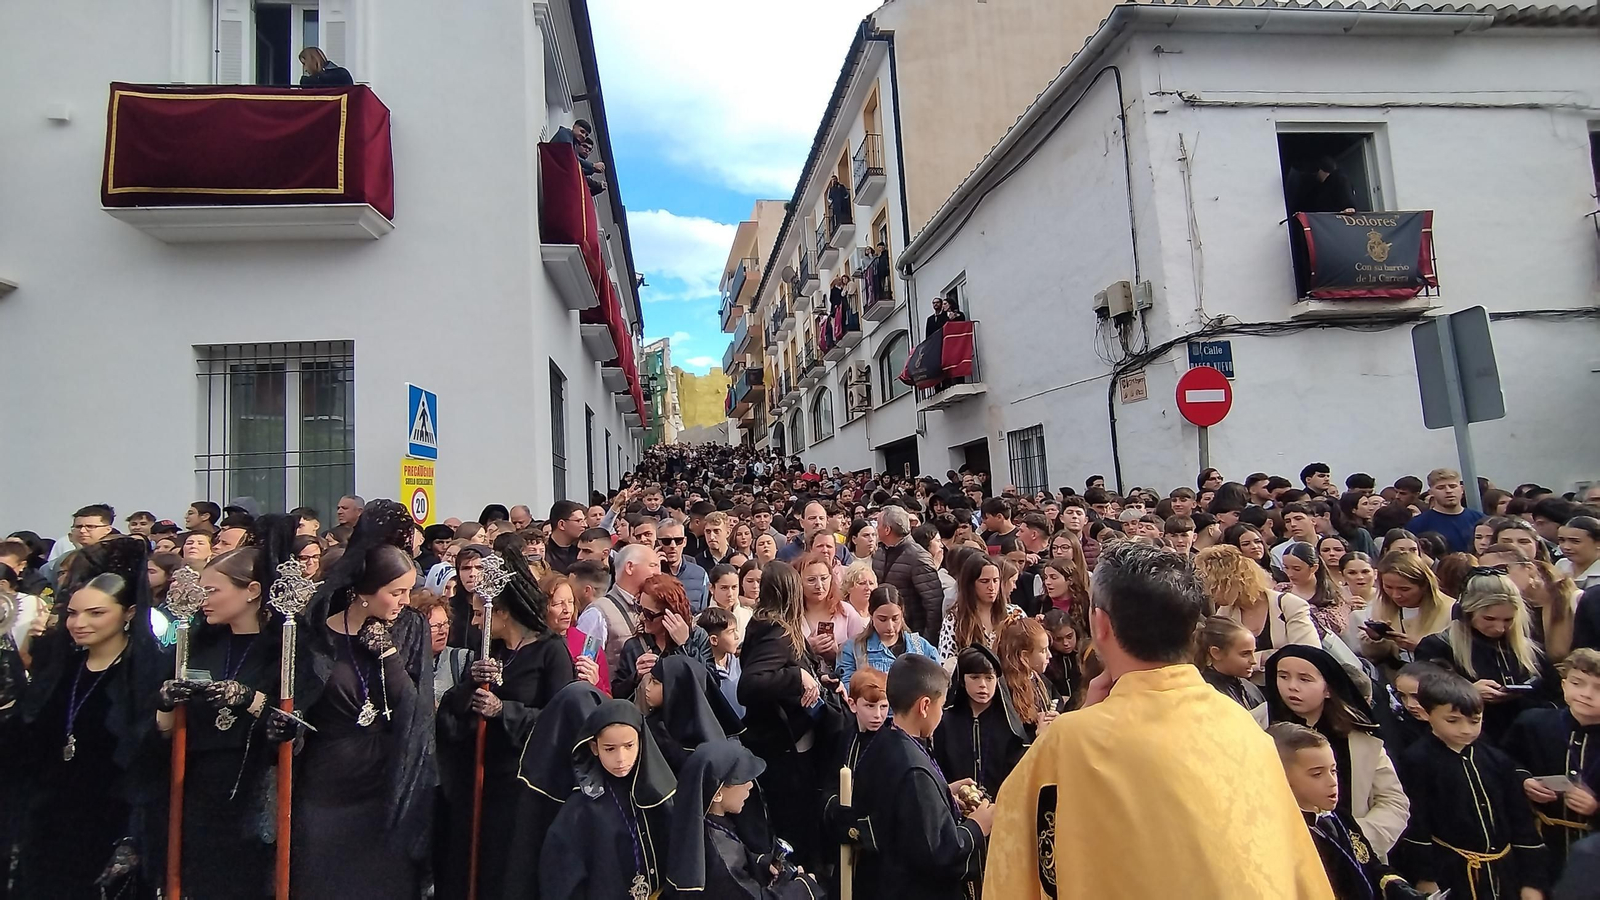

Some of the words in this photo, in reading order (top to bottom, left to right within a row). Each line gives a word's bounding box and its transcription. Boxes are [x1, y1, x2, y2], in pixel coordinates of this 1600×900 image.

[1355, 262, 1372, 271] Con
[1374, 263, 1383, 271] su
[1369, 274, 1376, 282] la
[1378, 274, 1409, 282] Carrera
[1203, 346, 1223, 355] Calle
[416, 498, 426, 513] 20
